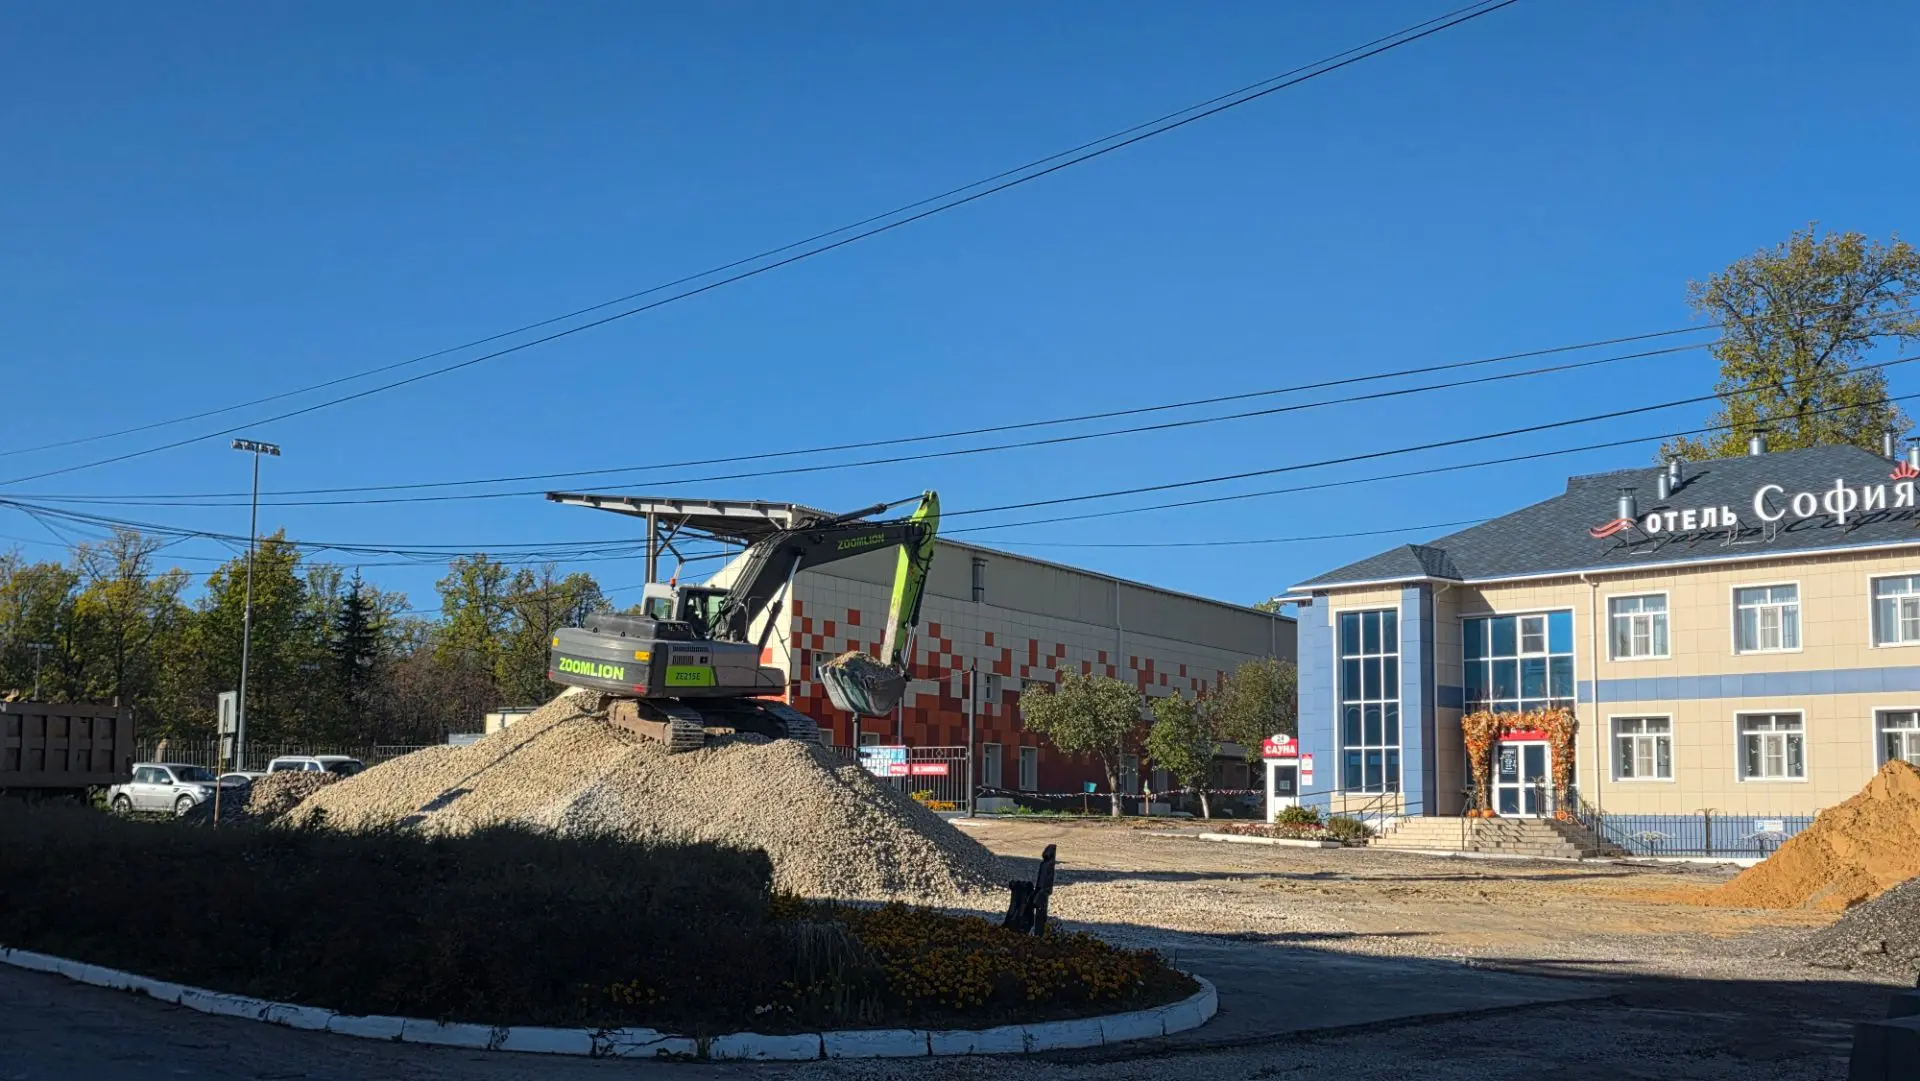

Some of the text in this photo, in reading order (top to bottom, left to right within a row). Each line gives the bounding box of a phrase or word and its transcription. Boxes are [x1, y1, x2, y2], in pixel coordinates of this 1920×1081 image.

[1646, 478, 1915, 533] ОТЕЛЬ София
[837, 532, 885, 550] ZOOMLION
[559, 657, 624, 680] ZOOMLION
[1265, 745, 1296, 755] САУНА
